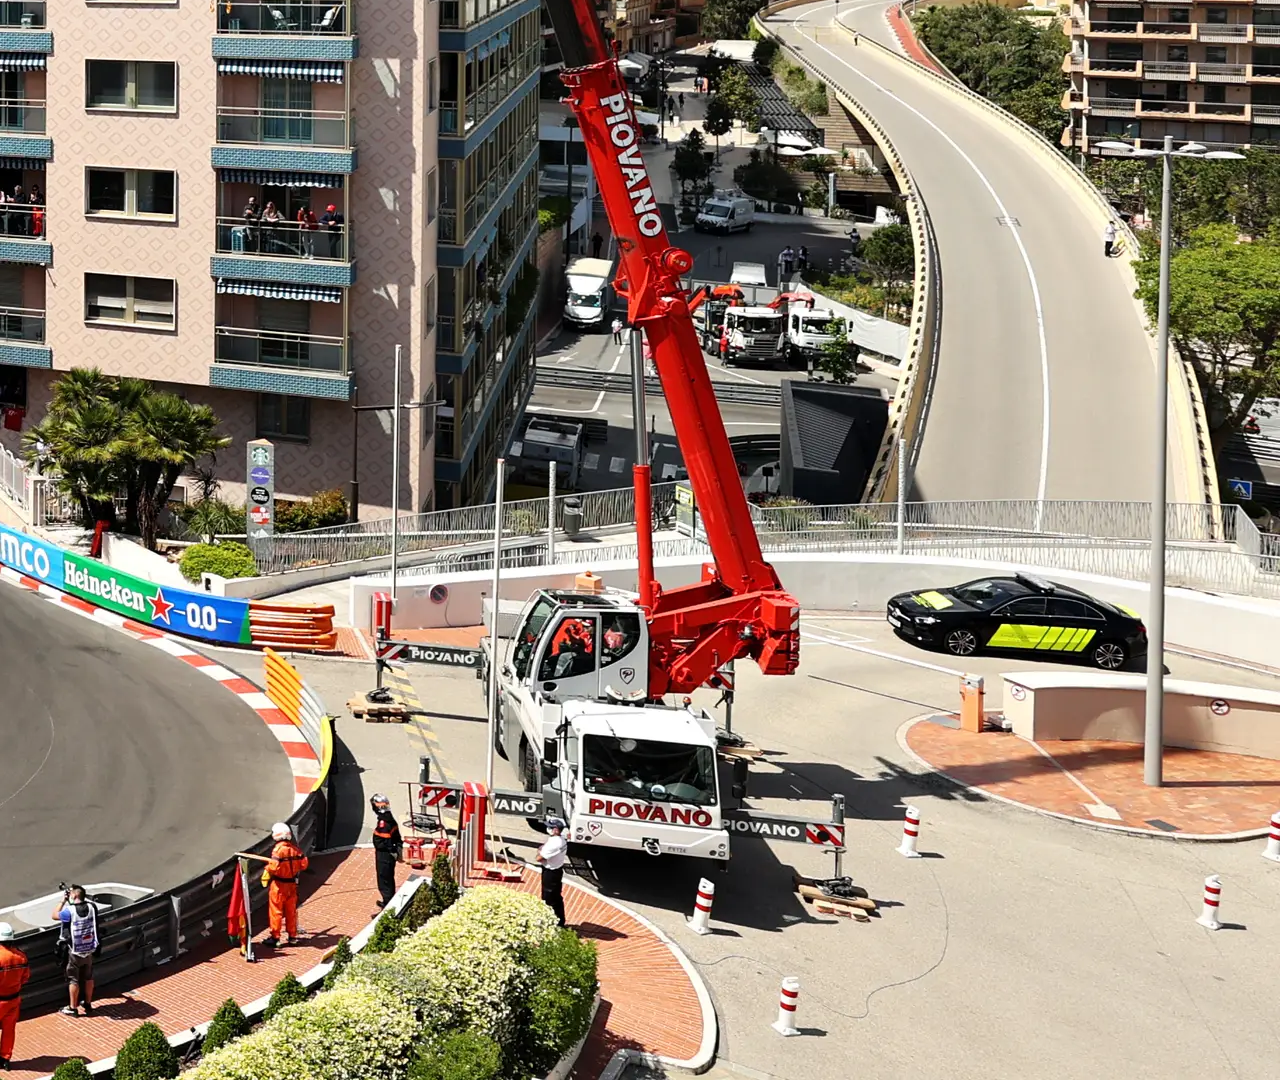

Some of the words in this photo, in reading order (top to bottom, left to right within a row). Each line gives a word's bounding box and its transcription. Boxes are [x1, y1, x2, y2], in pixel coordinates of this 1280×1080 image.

[599, 92, 663, 237] PIOVANO
[63, 560, 146, 613] Heineken
[411, 649, 476, 665] PIOVANO
[588, 798, 713, 827] PIOVANO
[722, 818, 800, 837] PIOVANO
